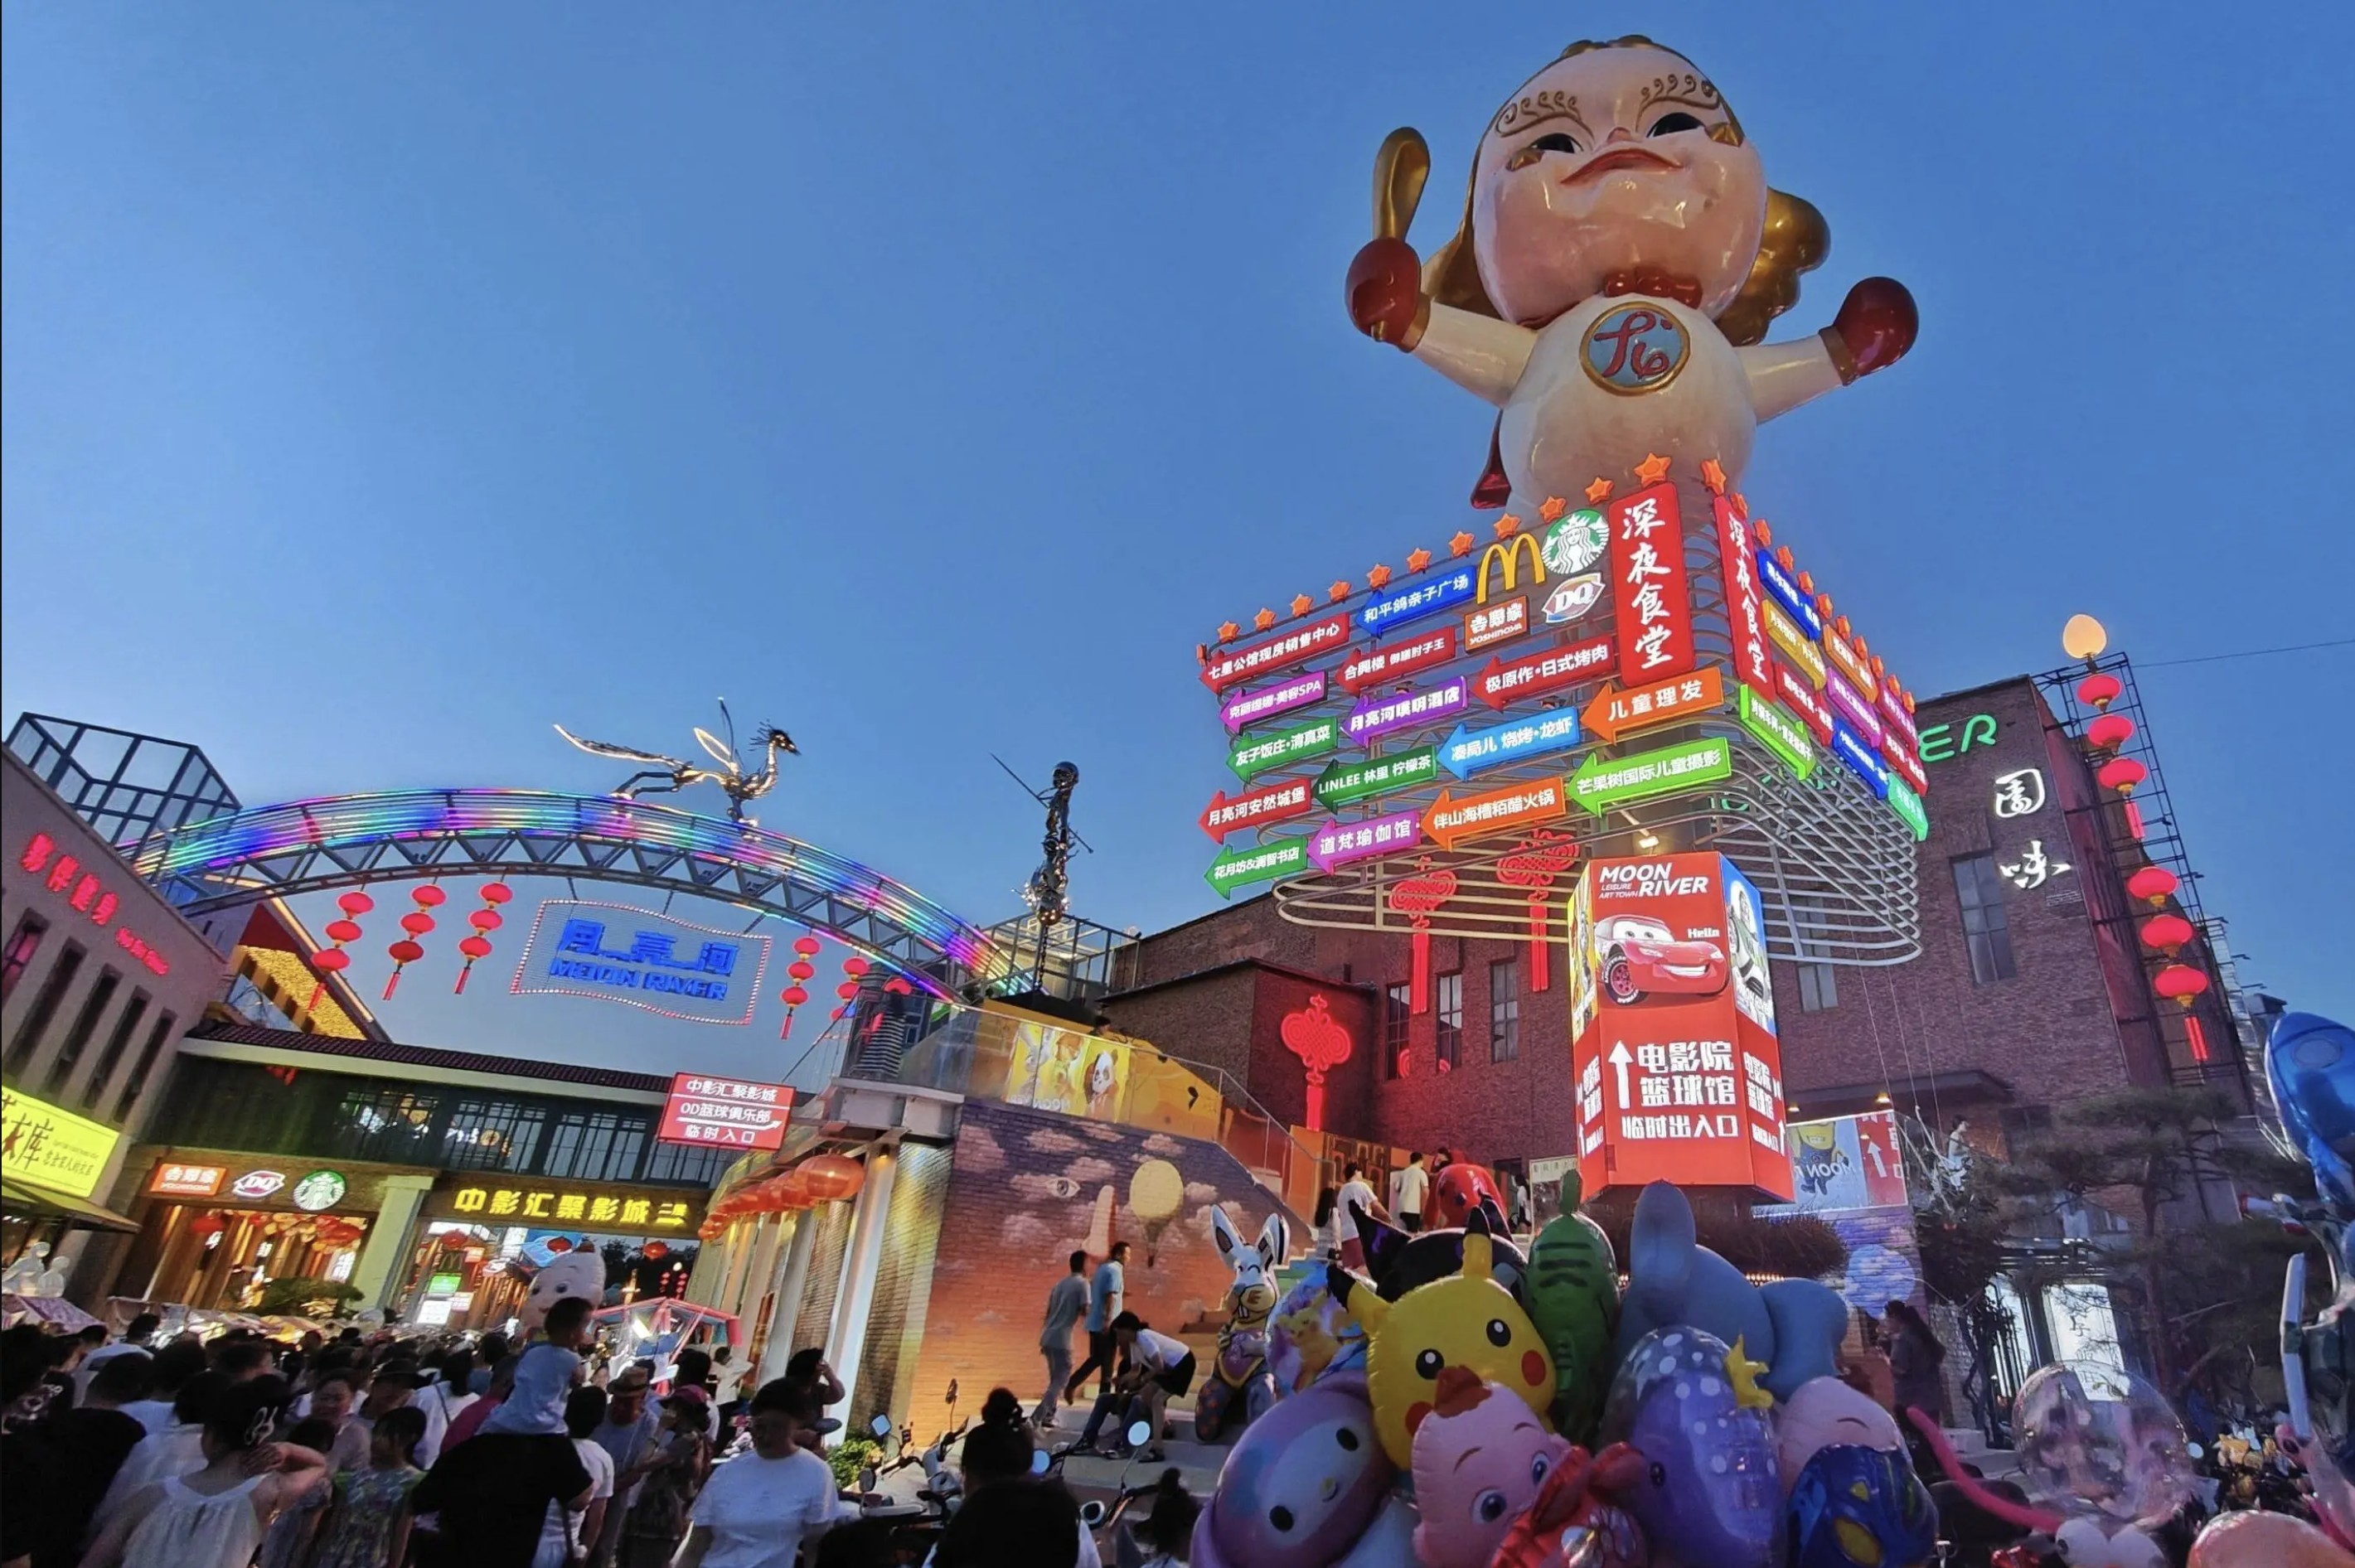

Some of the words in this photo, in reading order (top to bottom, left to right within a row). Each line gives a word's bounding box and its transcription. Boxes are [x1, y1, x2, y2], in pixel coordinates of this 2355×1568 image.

[1364, 573, 1469, 623] 和平鸽亲子广场
[1554, 583, 1597, 614] DQ
[1621, 497, 1674, 669] 深夜食堂
[1608, 680, 1703, 722] 儿童理发
[1319, 773, 1360, 794] LINLEE
[1364, 765, 1388, 784] 林里
[1577, 748, 1721, 795] 芒果树国际儿童摄影
[1208, 786, 1306, 826] 月亮河安然城堡
[1599, 863, 1672, 883] MOON
[1601, 883, 1632, 891] LEISURE
[1639, 877, 1709, 898] RIVER
[558, 918, 739, 977] 月亮河
[1688, 927, 1720, 939] Hello
[550, 958, 641, 987] MOON
[643, 972, 727, 1000] RIVER
[1637, 1041, 1735, 1073] 电影院
[686, 1078, 778, 1102] 中影汇聚影城
[1640, 1075, 1736, 1108] 篮球馆
[685, 1125, 755, 1144] 临时入口
[1621, 1115, 1739, 1140] 临时出入口
[248, 1175, 275, 1189] DQ
[454, 1188, 651, 1224] 中影汇聚影城
